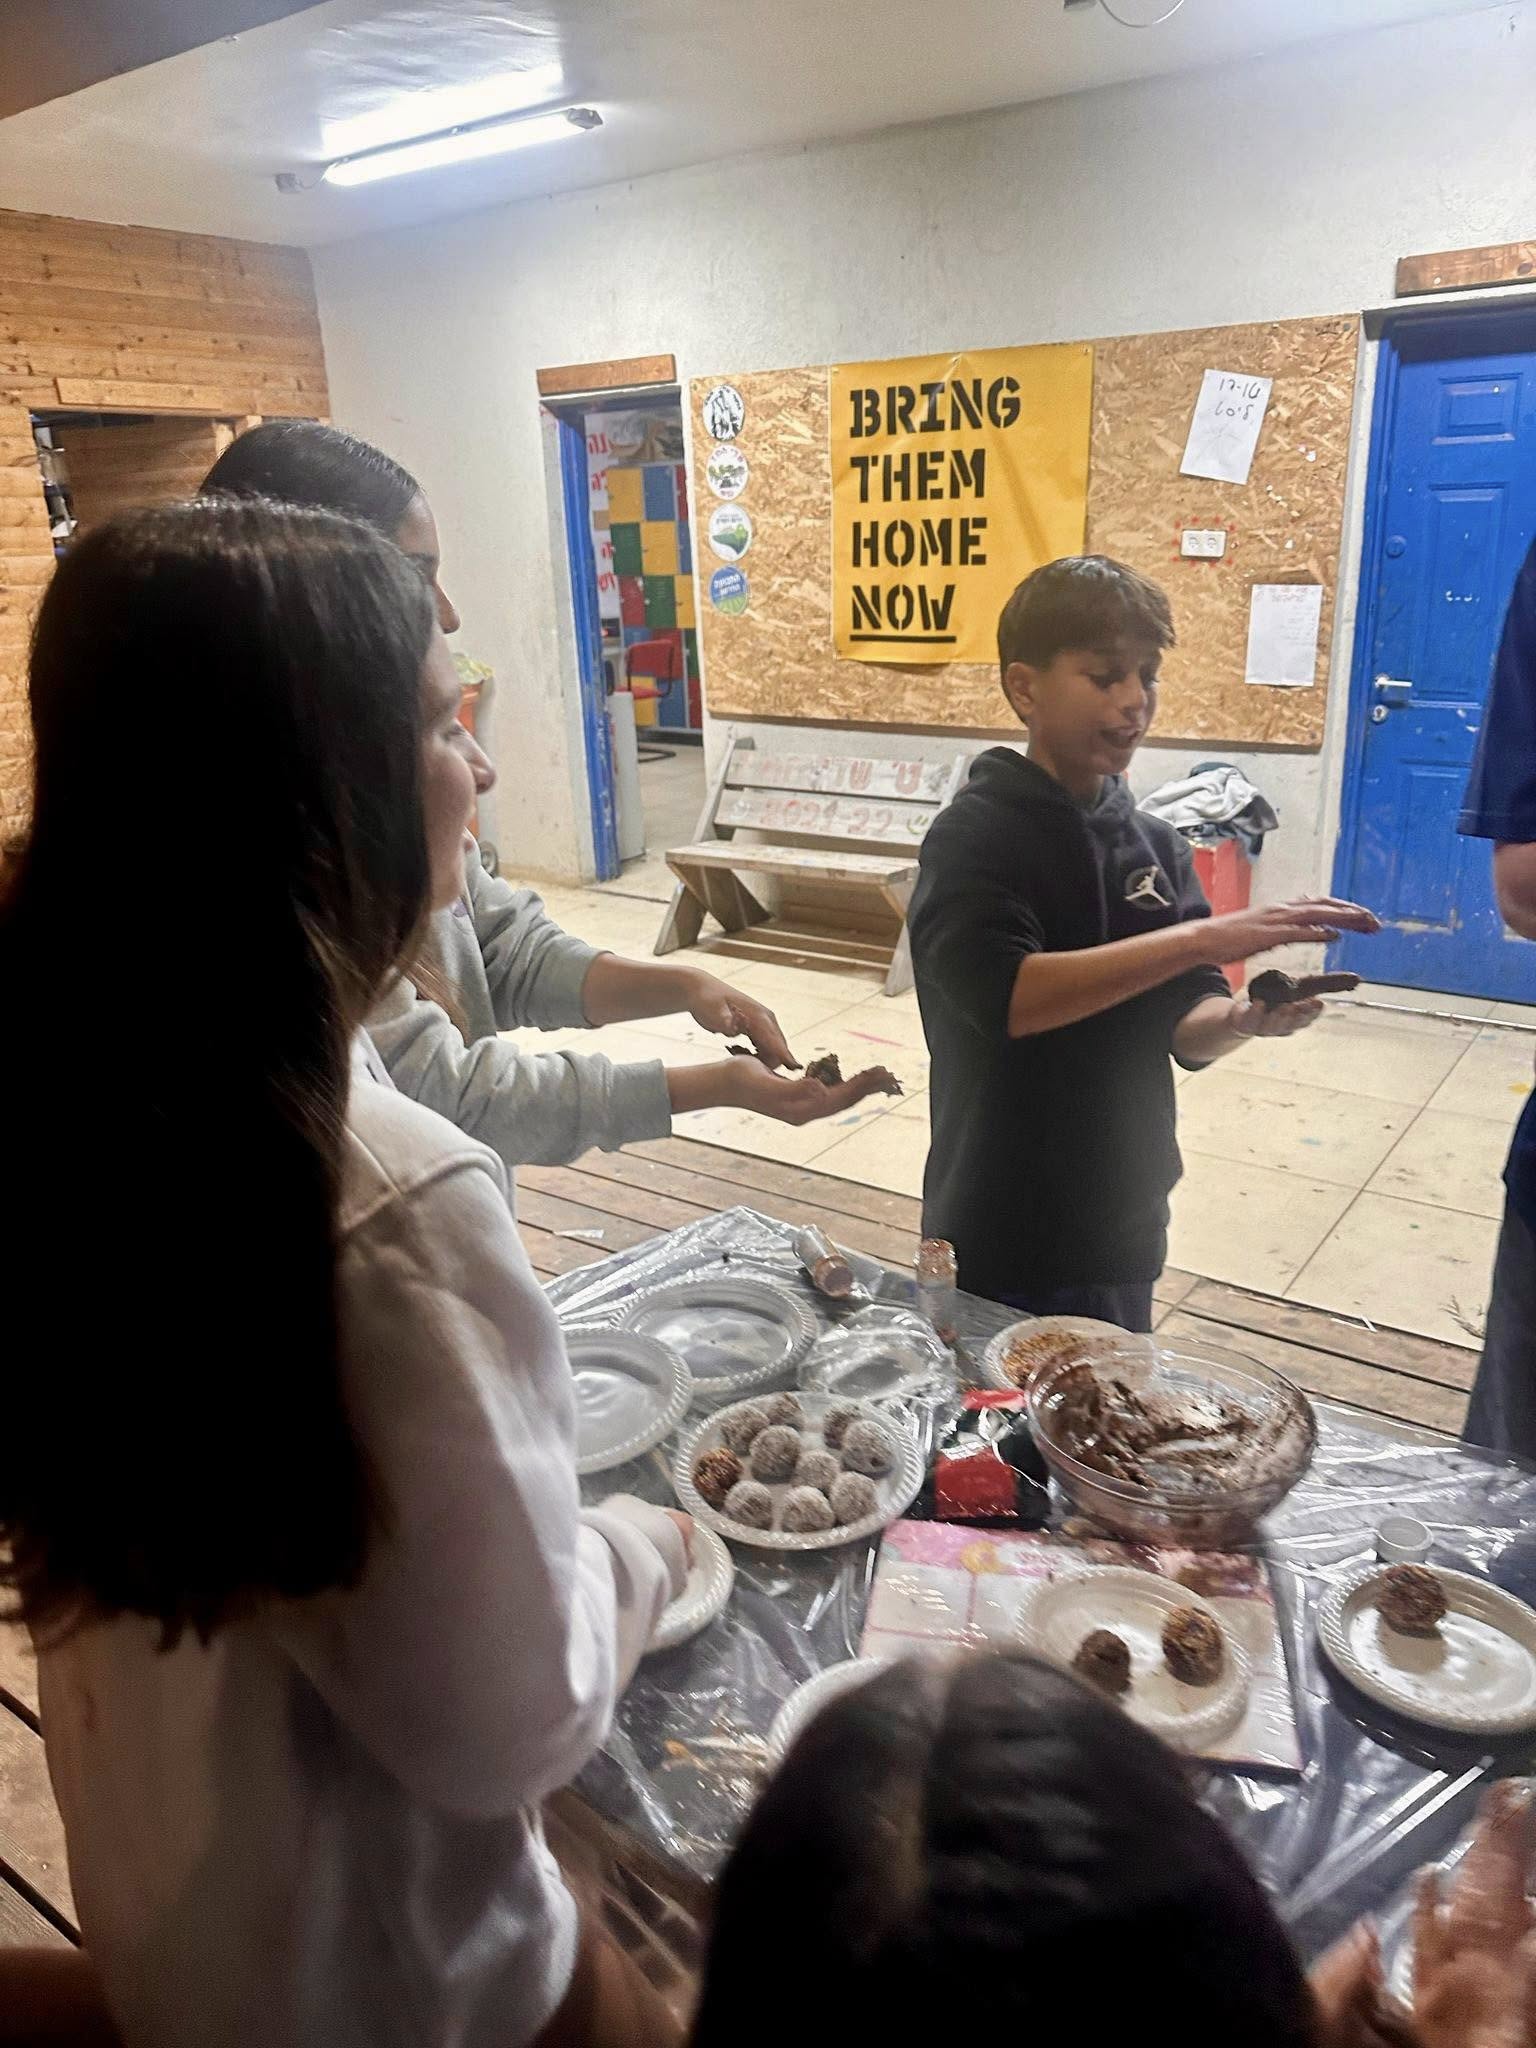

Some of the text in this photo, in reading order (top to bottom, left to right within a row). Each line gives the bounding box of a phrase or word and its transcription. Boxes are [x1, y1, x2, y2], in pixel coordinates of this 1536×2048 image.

[850, 376, 1020, 438] BRING
[850, 448, 985, 503] THEM
[852, 517, 987, 567] HOME
[852, 583, 956, 630] NOW
